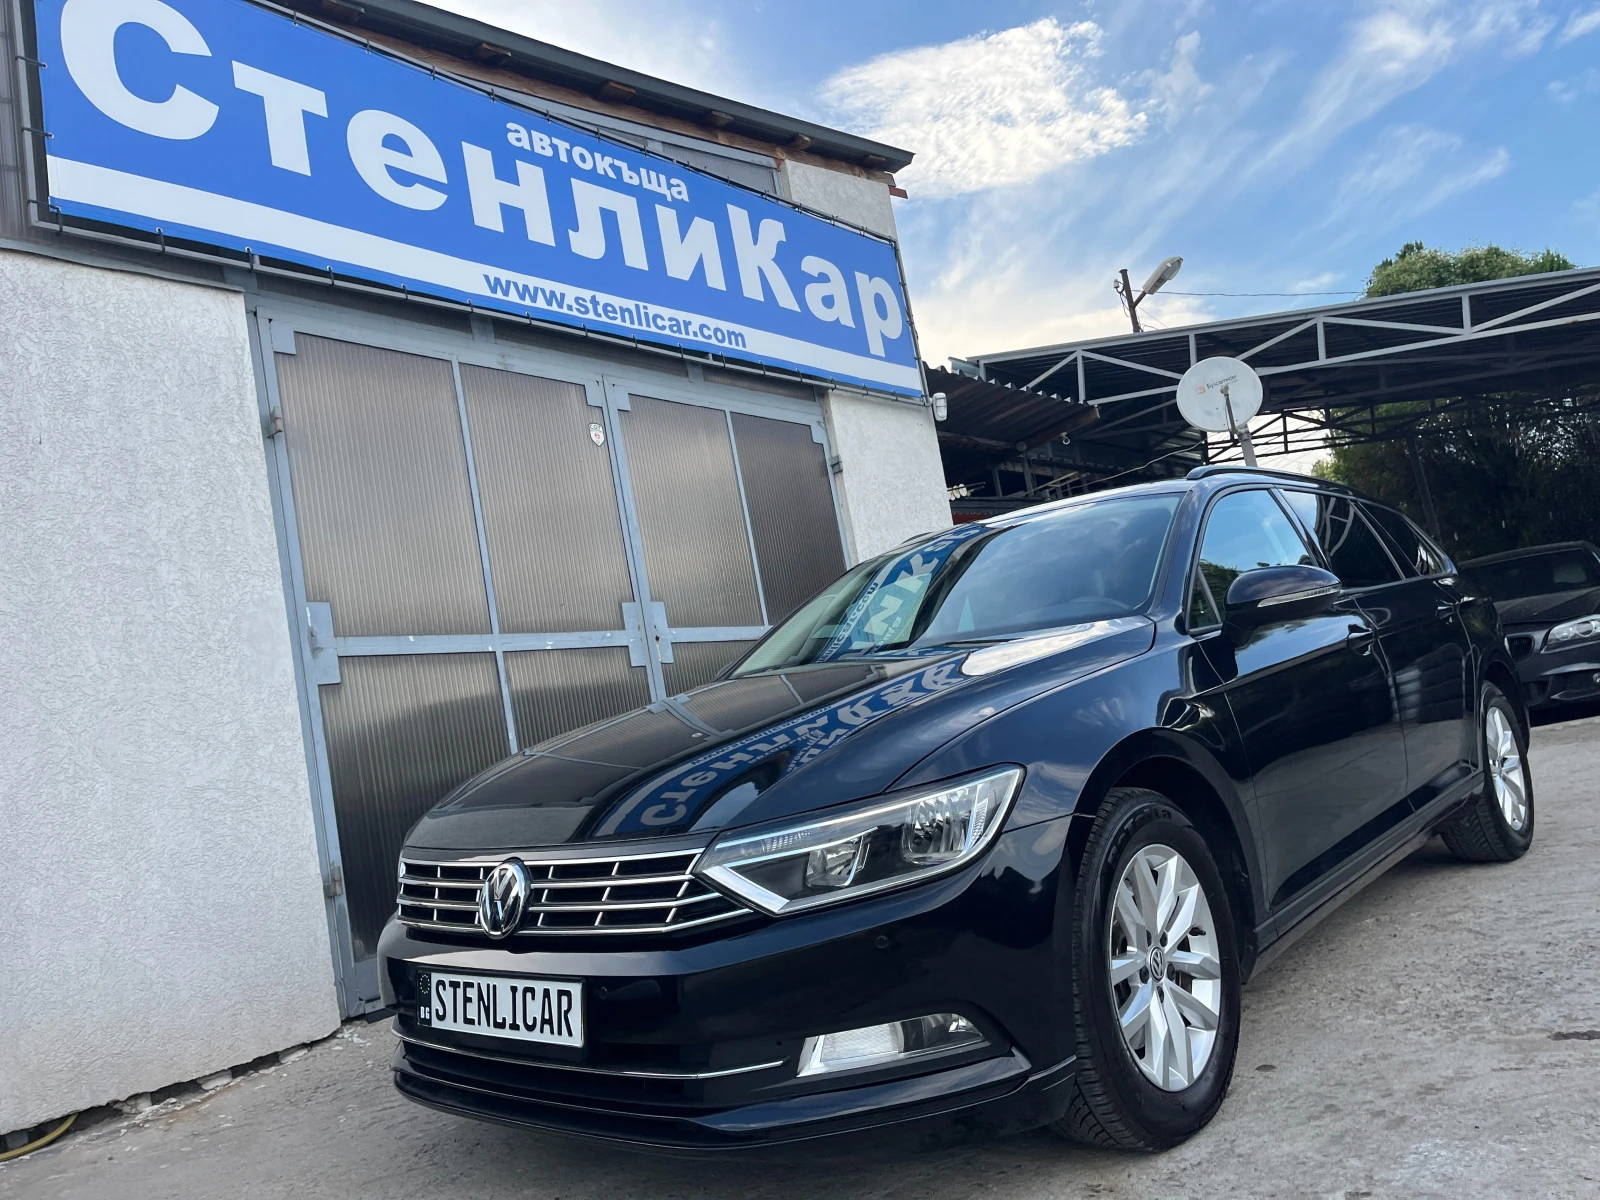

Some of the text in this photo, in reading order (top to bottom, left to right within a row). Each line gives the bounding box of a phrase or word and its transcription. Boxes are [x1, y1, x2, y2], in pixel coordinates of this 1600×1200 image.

[60, 0, 903, 357] СтенлиКар
[506, 121, 690, 202] автокъща
[483, 273, 748, 349] www.stenlicar.com
[420, 1006, 430, 1020] BG
[435, 979, 573, 1036] STENLICAR
